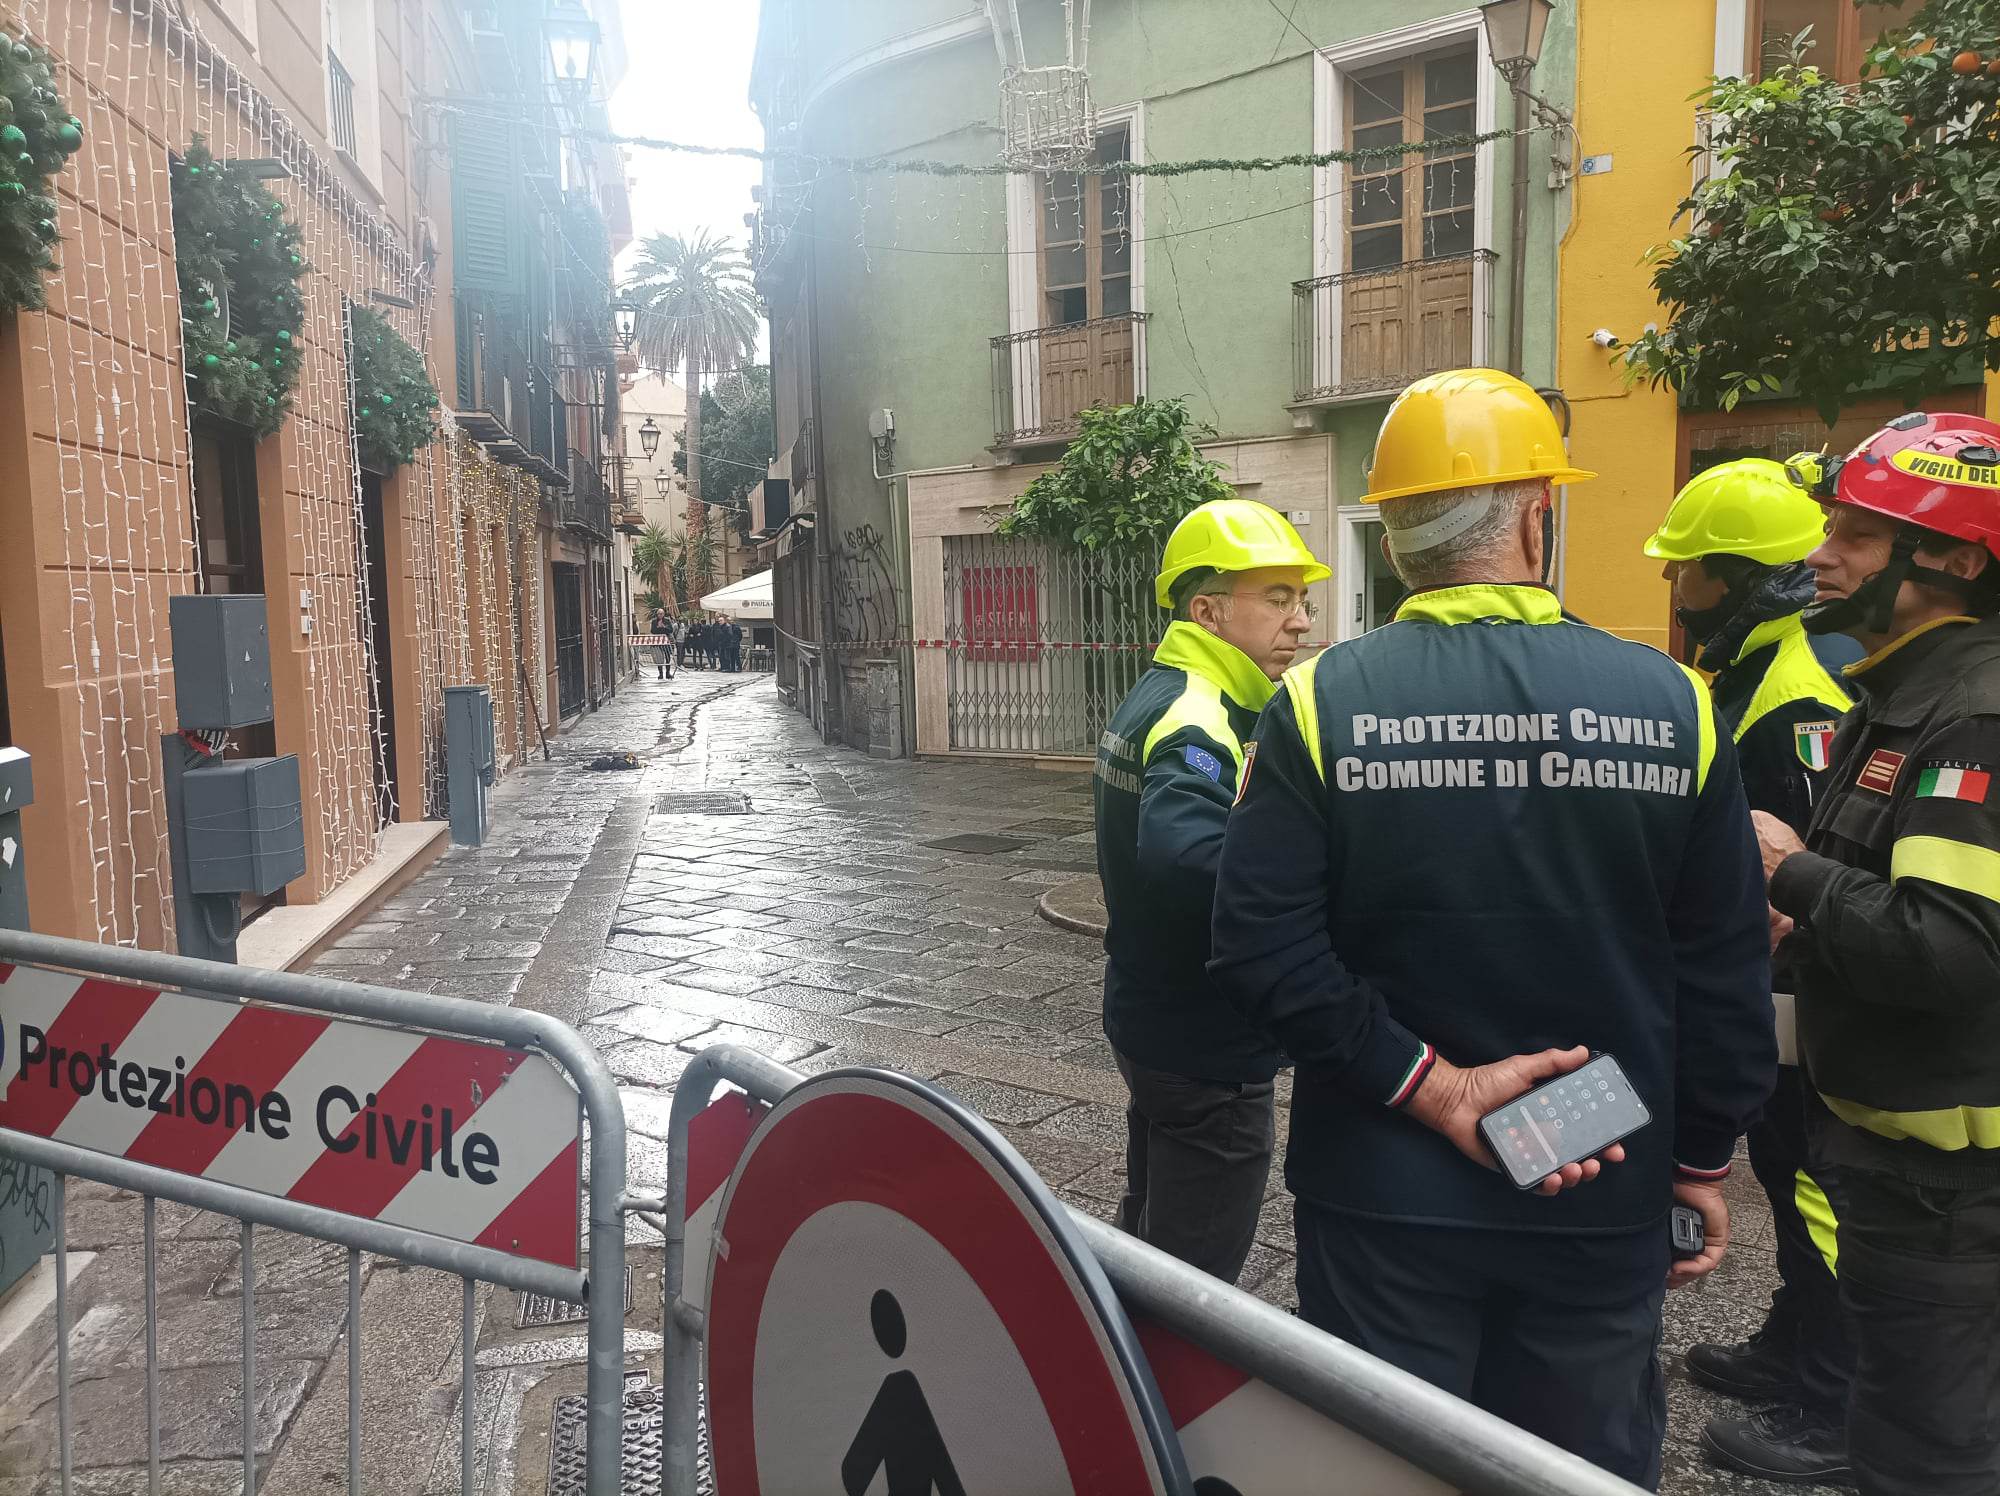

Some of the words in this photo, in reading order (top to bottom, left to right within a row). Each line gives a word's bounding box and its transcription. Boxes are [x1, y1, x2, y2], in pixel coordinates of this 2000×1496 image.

[1908, 457, 1963, 480] VIGILI
[1968, 466, 1998, 484] DEL
[1352, 713, 1560, 747] PROTEZIONE
[1569, 707, 1676, 749] CIVILE
[1800, 724, 1829, 732] ITALIA
[1335, 756, 1486, 792] COMUNE
[1495, 759, 1529, 788] DI
[1539, 751, 1692, 797] CAGLIARI
[1928, 761, 1981, 771] ITALIA
[19, 1023, 292, 1140] Protezione
[316, 1085, 500, 1185] Civile
